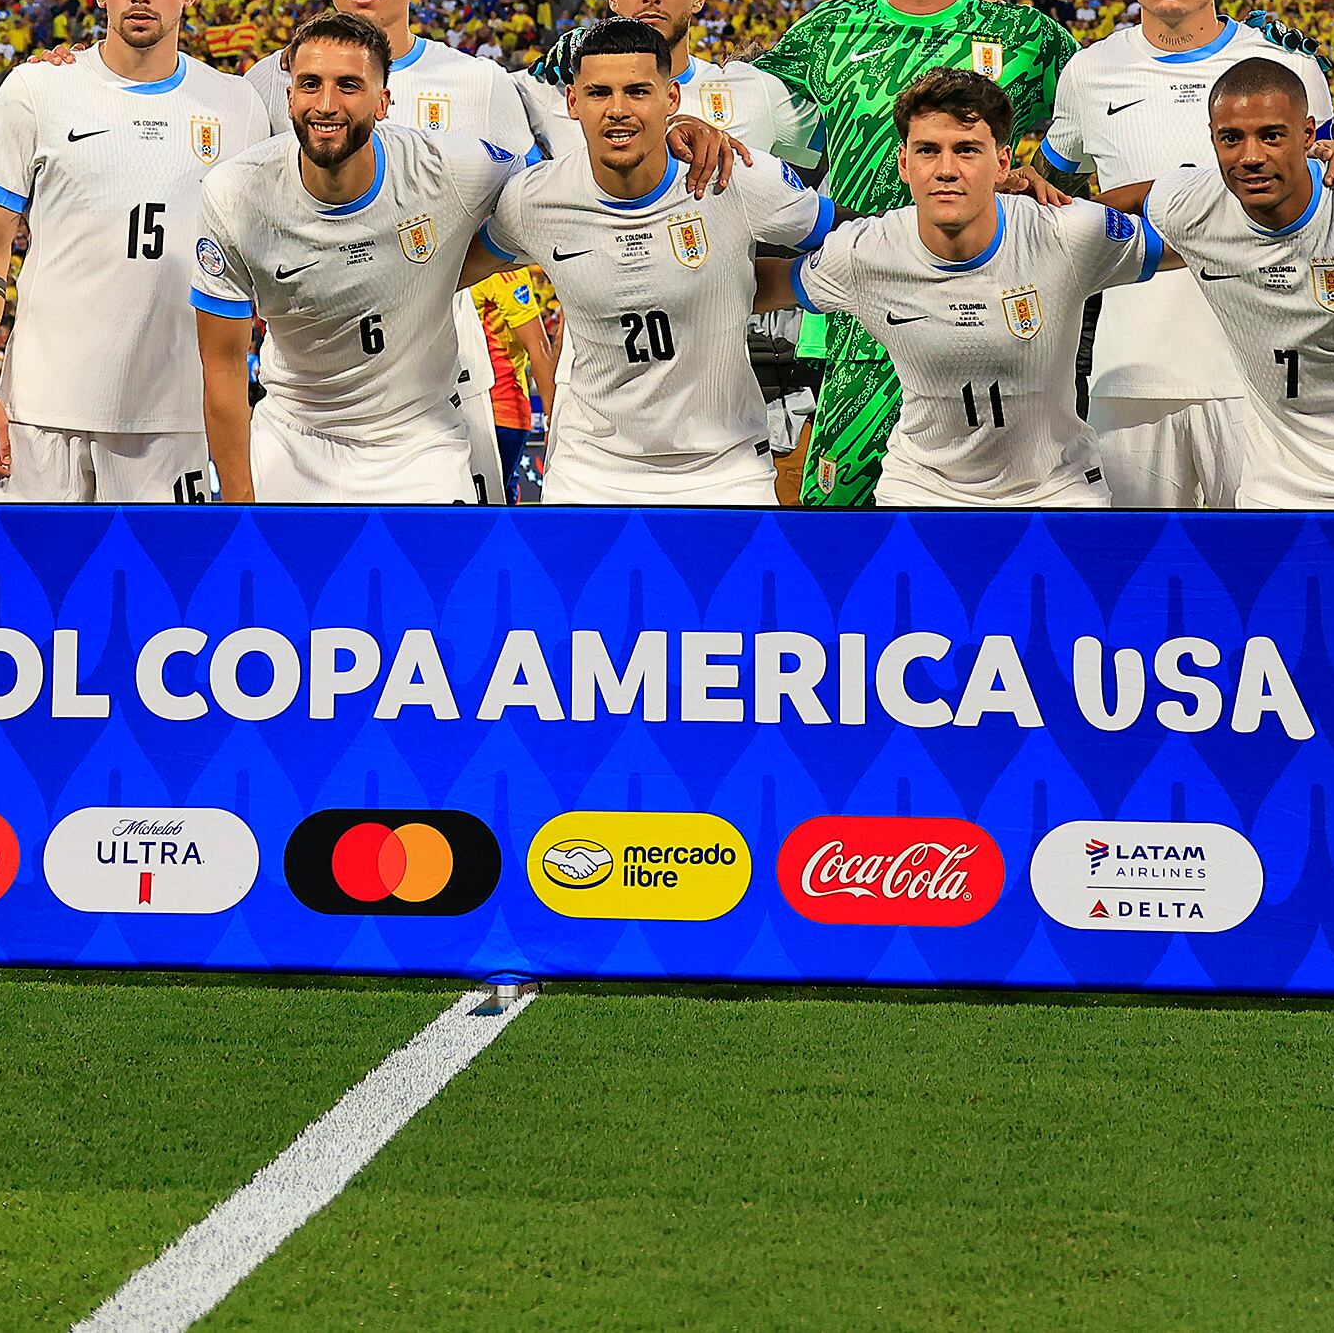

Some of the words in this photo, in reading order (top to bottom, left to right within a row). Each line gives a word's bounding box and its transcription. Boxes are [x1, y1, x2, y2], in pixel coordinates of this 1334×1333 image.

[127, 202, 166, 260] 15
[614, 235, 625, 243] VS.
[625, 232, 654, 242] COLOMBIA
[347, 239, 376, 251] COLOMBIA
[1268, 265, 1297, 273] COLOMBIA
[959, 303, 988, 311] COLOMBIA
[359, 314, 385, 356] 6
[619, 310, 676, 364] 20
[1273, 348, 1299, 399] 7
[961, 379, 1006, 429] 11
[135, 627, 461, 721] COPA
[477, 629, 1045, 729] AMERICA
[1073, 636, 1316, 741] USA
[112, 818, 185, 838] Michelob
[98, 840, 201, 865] ULTRA
[623, 842, 737, 868] mercado
[1116, 845, 1206, 862] LATAM
[623, 865, 685, 888] libre
[801, 840, 979, 901] Coca-Cola
[1116, 867, 1206, 879] AIRLINES
[1118, 901, 1204, 919] DELTA
